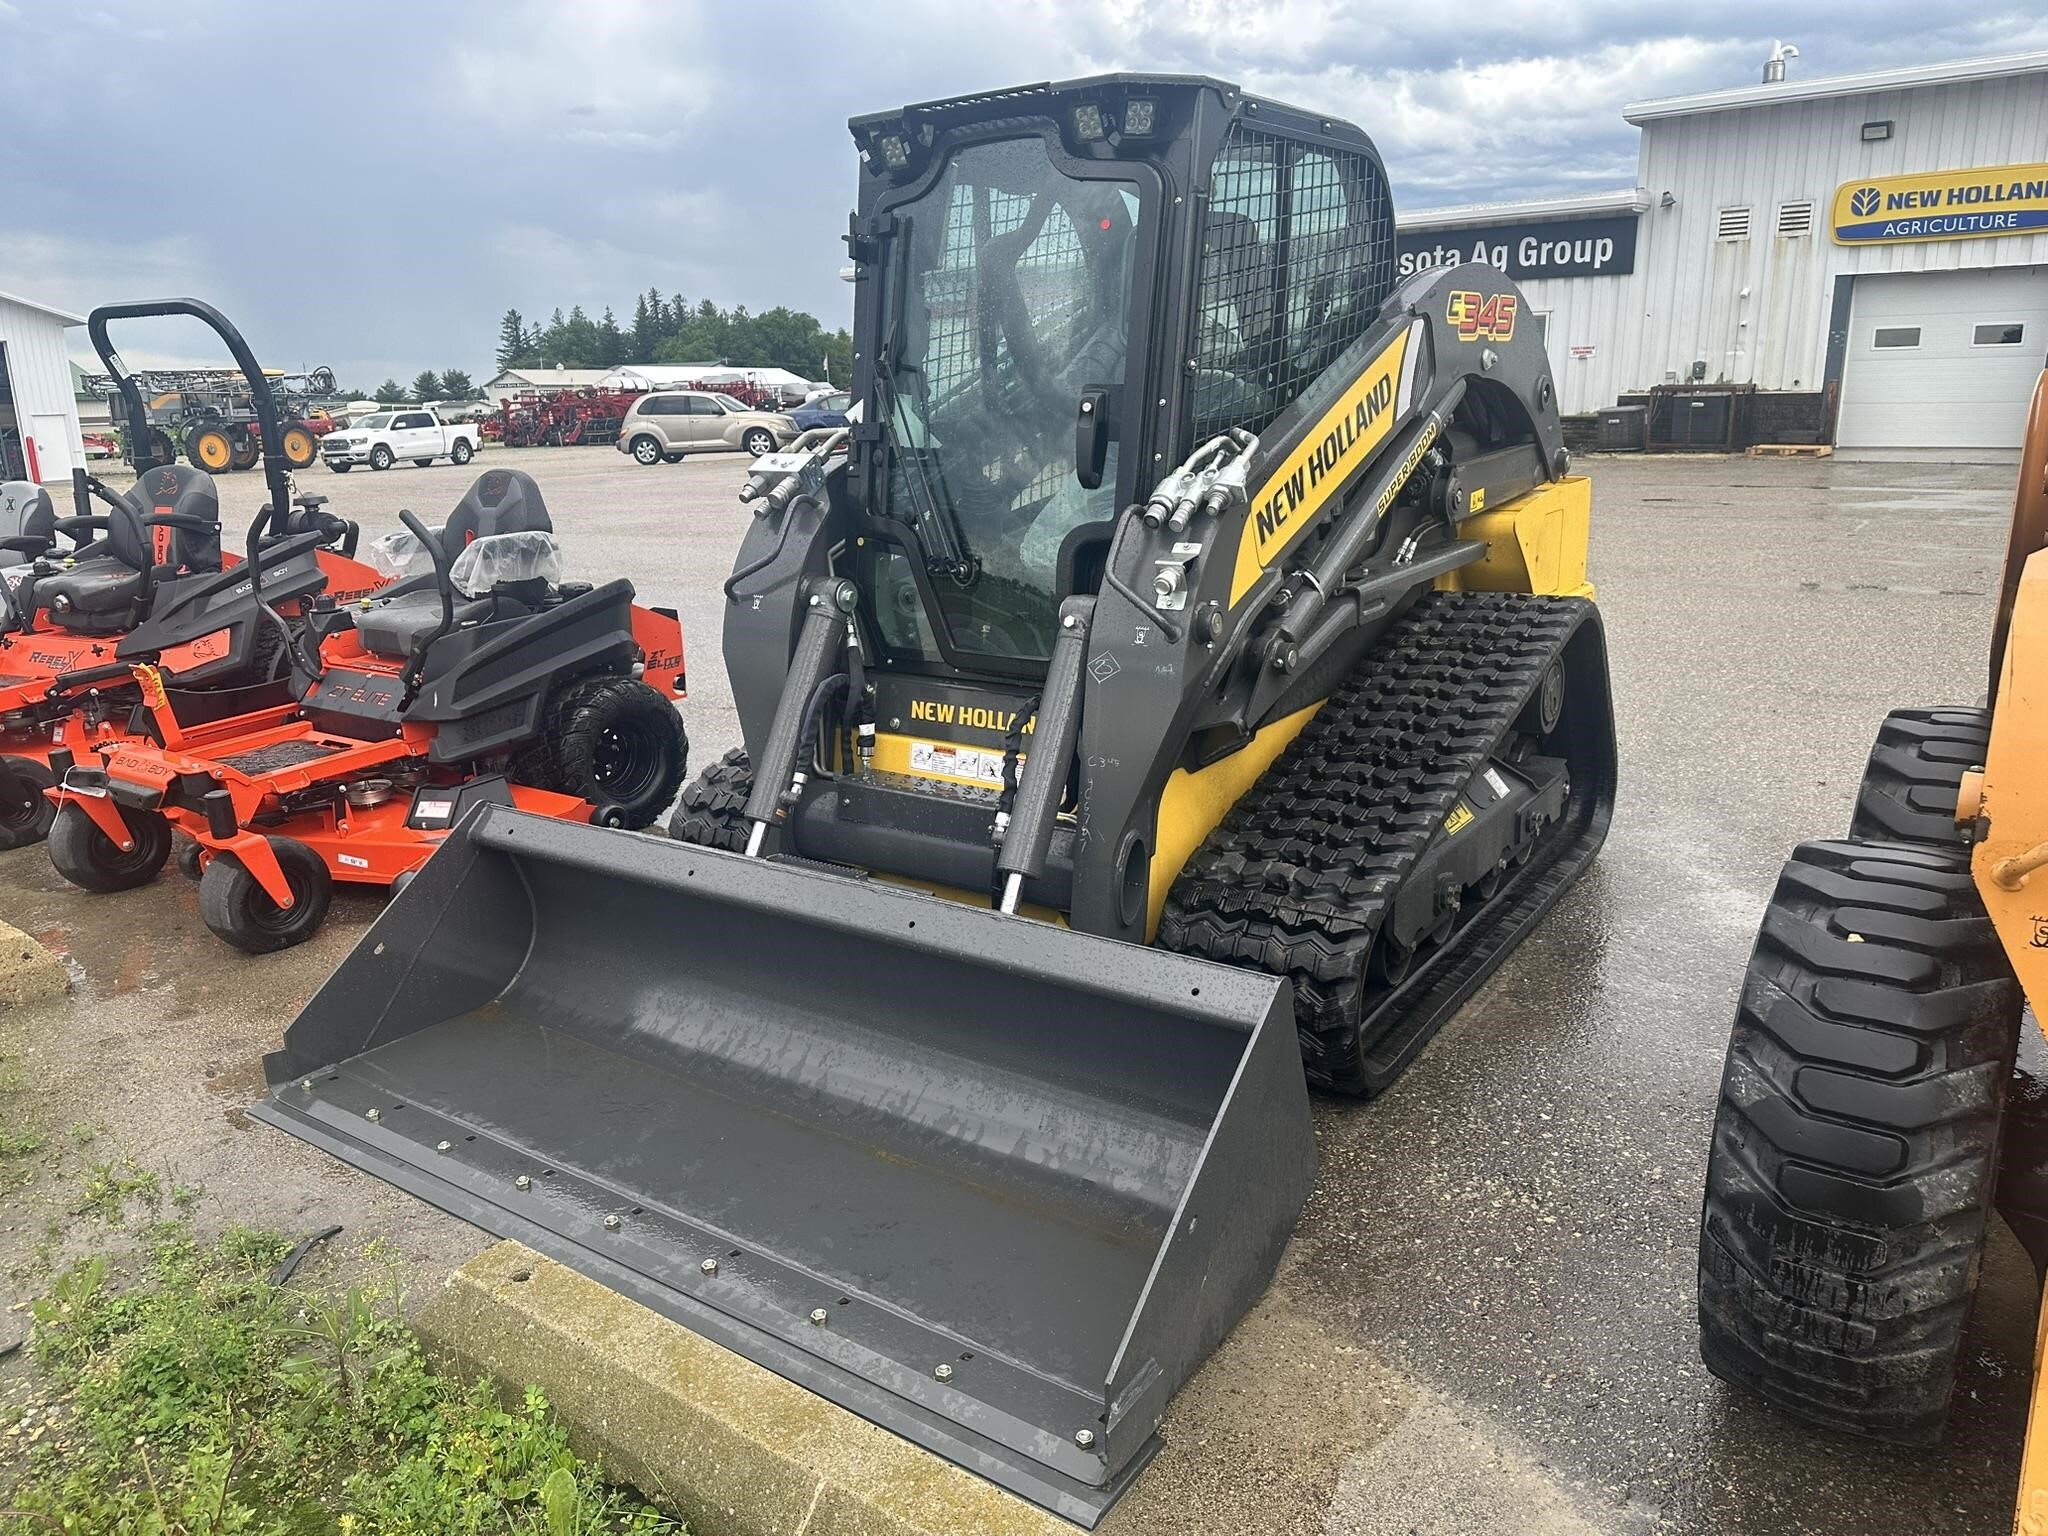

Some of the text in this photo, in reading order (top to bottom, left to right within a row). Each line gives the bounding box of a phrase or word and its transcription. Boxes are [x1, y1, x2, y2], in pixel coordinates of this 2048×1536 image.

[1886, 189, 1942, 211] NEW
[1883, 213, 2018, 236] AGRICULTURE
[1395, 236, 1614, 276] sota Ag Group
[1447, 291, 1517, 341] C345
[1255, 373, 1392, 546] NEW HOLLAND
[1376, 423, 1437, 516] SUPER BOOM
[235, 567, 288, 595] BAD BOY
[650, 649, 666, 659] ZT
[327, 684, 392, 706] ZT ELITE
[911, 700, 1037, 735] NEW HOLLAN
[116, 756, 173, 776] BAD BOY
